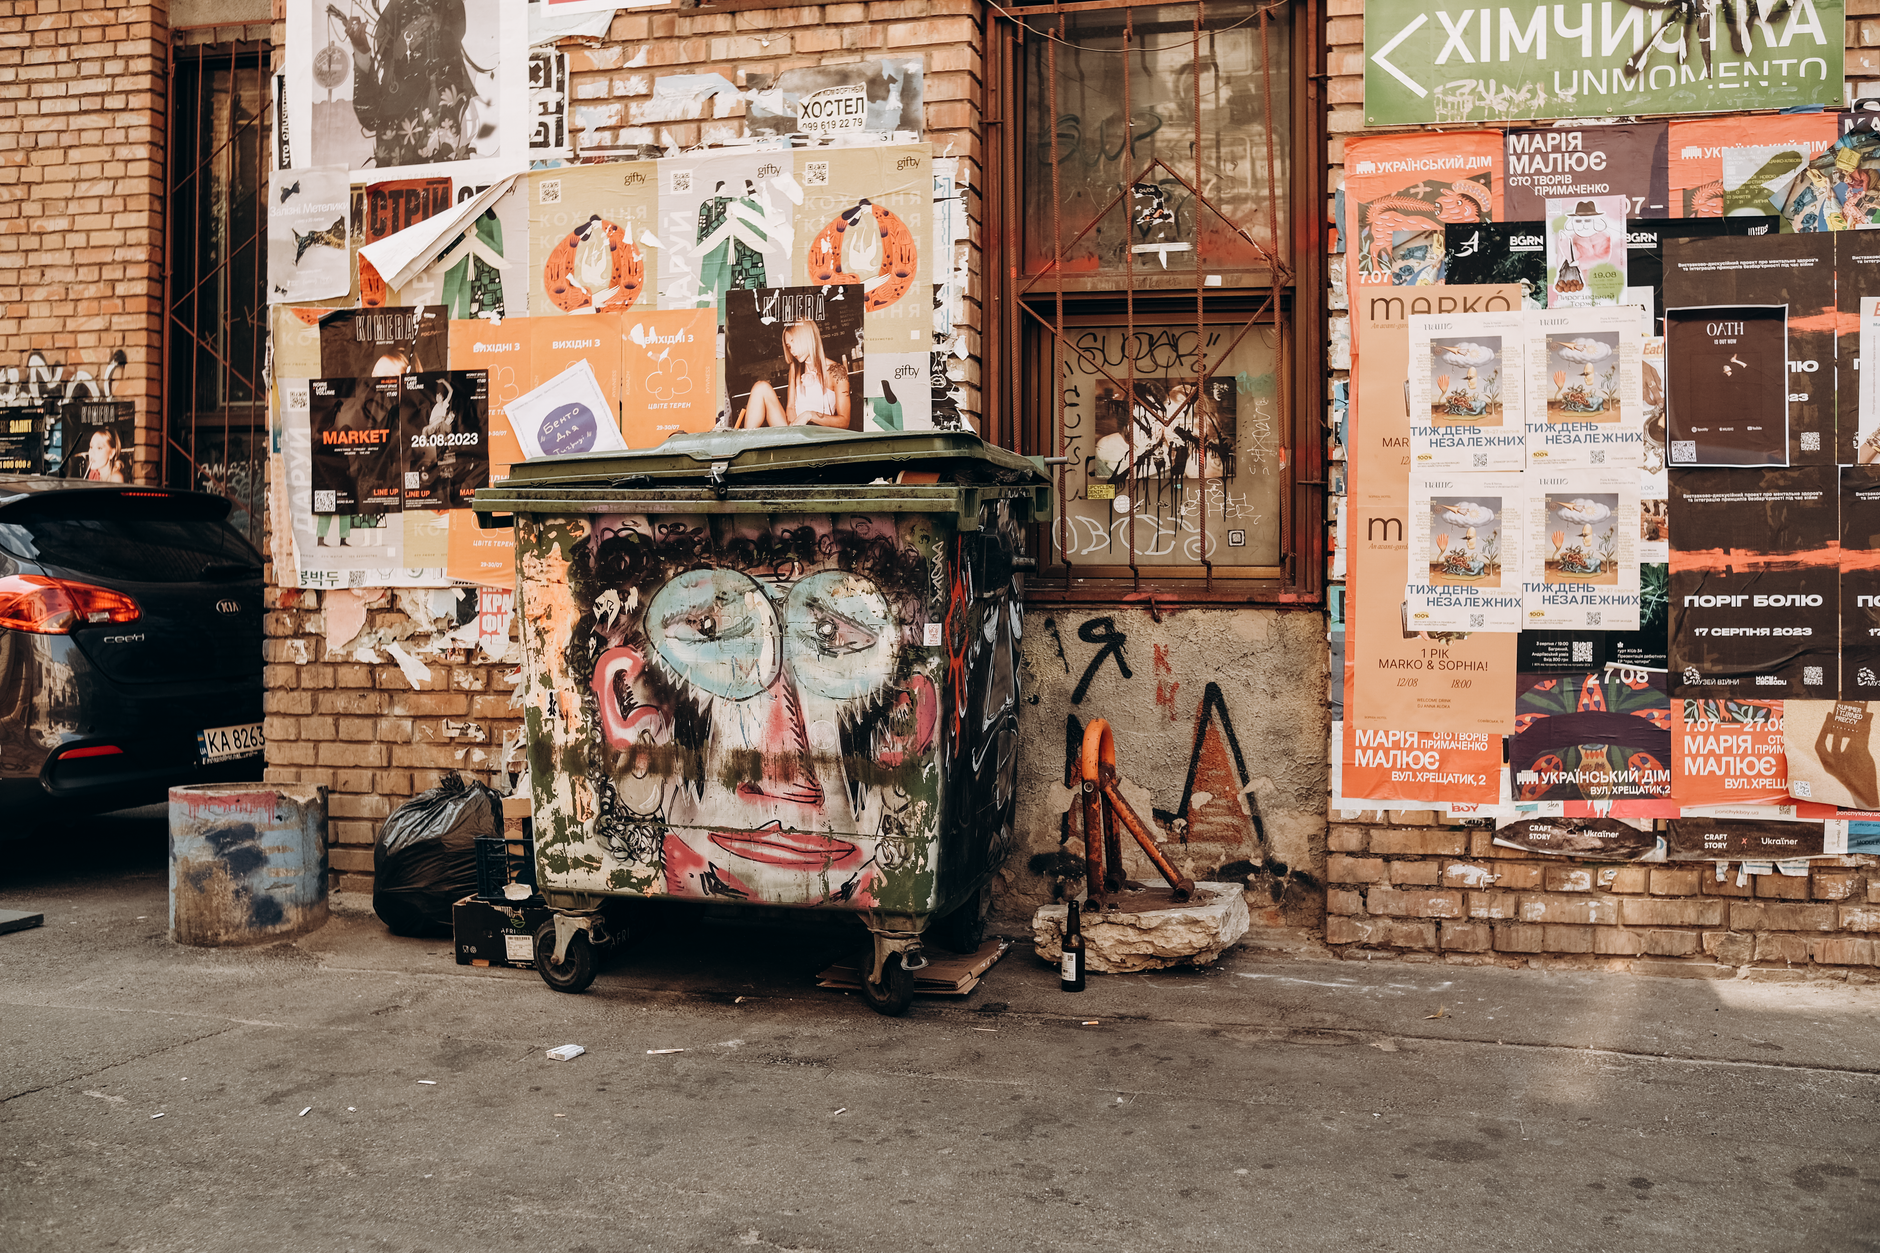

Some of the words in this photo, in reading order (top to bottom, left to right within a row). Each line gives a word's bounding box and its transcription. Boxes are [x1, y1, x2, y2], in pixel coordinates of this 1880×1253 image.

[801, 97, 864, 119] ХОСТЕЛ
[821, 119, 836, 130] 619
[839, 118, 849, 128] 22
[852, 118, 862, 127] 79
[1509, 132, 1582, 154] МАРІЯ
[897, 156, 920, 170] gifty
[1378, 154, 1464, 173] УКРАЇНСЬКИЙ
[1466, 156, 1492, 170] ДІМ
[1509, 152, 1606, 174] МАЛЮЄ
[757, 164, 782, 178] gifty
[624, 172, 646, 185] gifty
[1509, 176, 1530, 186] СТО
[1533, 175, 1572, 185] ТВОРІВ
[1535, 183, 1609, 196] ПРИМАЧЕНКО
[270, 205, 300, 217] Залізні
[302, 201, 350, 214] Метелики
[1510, 235, 1543, 247] BGRN
[1359, 270, 1391, 284] 7.07
[763, 294, 825, 322] KIMERA
[1707, 322, 1744, 336] OATH
[552, 340, 591, 350] ВИХІДНІ
[644, 335, 685, 345] ВИХІДНІ
[473, 343, 511, 353] ВИХІДНІ
[894, 364, 920, 379] gifty
[1788, 360, 1819, 373] ЛЮ
[1788, 393, 1809, 402] 23
[648, 402, 669, 410] ЦВІТЕ
[671, 401, 691, 410] ТЕРЕН
[543, 408, 579, 435] Бенто
[322, 429, 390, 446] MARKET
[411, 432, 479, 448] 26.08.2023
[1382, 438, 1409, 447] MAR
[1430, 436, 1525, 448] НЕЗАЛЕЖНИХ
[1545, 432, 1642, 445] НЕЗАЛЕЖНИХ
[1427, 596, 1522, 608] НЕЗАЛЕЖНИХ
[1542, 595, 1639, 606] НЕЗАЛЕЖНИХ
[1684, 595, 1749, 608] ПОРІГ
[1754, 594, 1823, 607] БОЛЮ
[221, 602, 239, 613] KIA
[104, 633, 144, 644] cee'd
[1694, 628, 1706, 636] 17
[1711, 628, 1770, 636] СЕРПНЯ
[1773, 628, 1812, 636] 2023
[1421, 649, 1426, 658] 1
[1430, 649, 1449, 658] РІК
[1378, 659, 1422, 670] MARKO
[1426, 660, 1435, 670] &
[1438, 660, 1488, 671] SOPHIA!
[1396, 678, 1418, 688] 12/08
[1451, 678, 1472, 689] 18:00
[1684, 718, 1716, 732] 7.07
[208, 731, 231, 753] KA
[232, 726, 265, 749] 8263
[1355, 729, 1418, 748] МАРІЯ
[1454, 732, 1488, 741] ТВОРІВ
[1684, 735, 1752, 754] МАРІЯ
[1420, 740, 1488, 751] ПРИМАЧЕНКО
[1755, 745, 1786, 754] ПРИМ
[1355, 749, 1439, 770] МАЛЮЄ
[1684, 757, 1776, 776] МАЛЮЄ
[1392, 771, 1414, 782] ВУЛ.
[1416, 772, 1477, 786] ХРЕЩАТИК,
[1479, 775, 1486, 785] 2
[1541, 768, 1638, 784] УКРАЇНСЬКИЙ
[1641, 769, 1670, 784] ДІМ
[1725, 779, 1750, 789] ВУЛ.
[1590, 786, 1611, 796] ВУЛ.
[1452, 802, 1478, 812] BOY
[1584, 829, 1619, 838] Ukraïner
[1761, 837, 1798, 846] Ukraïner
